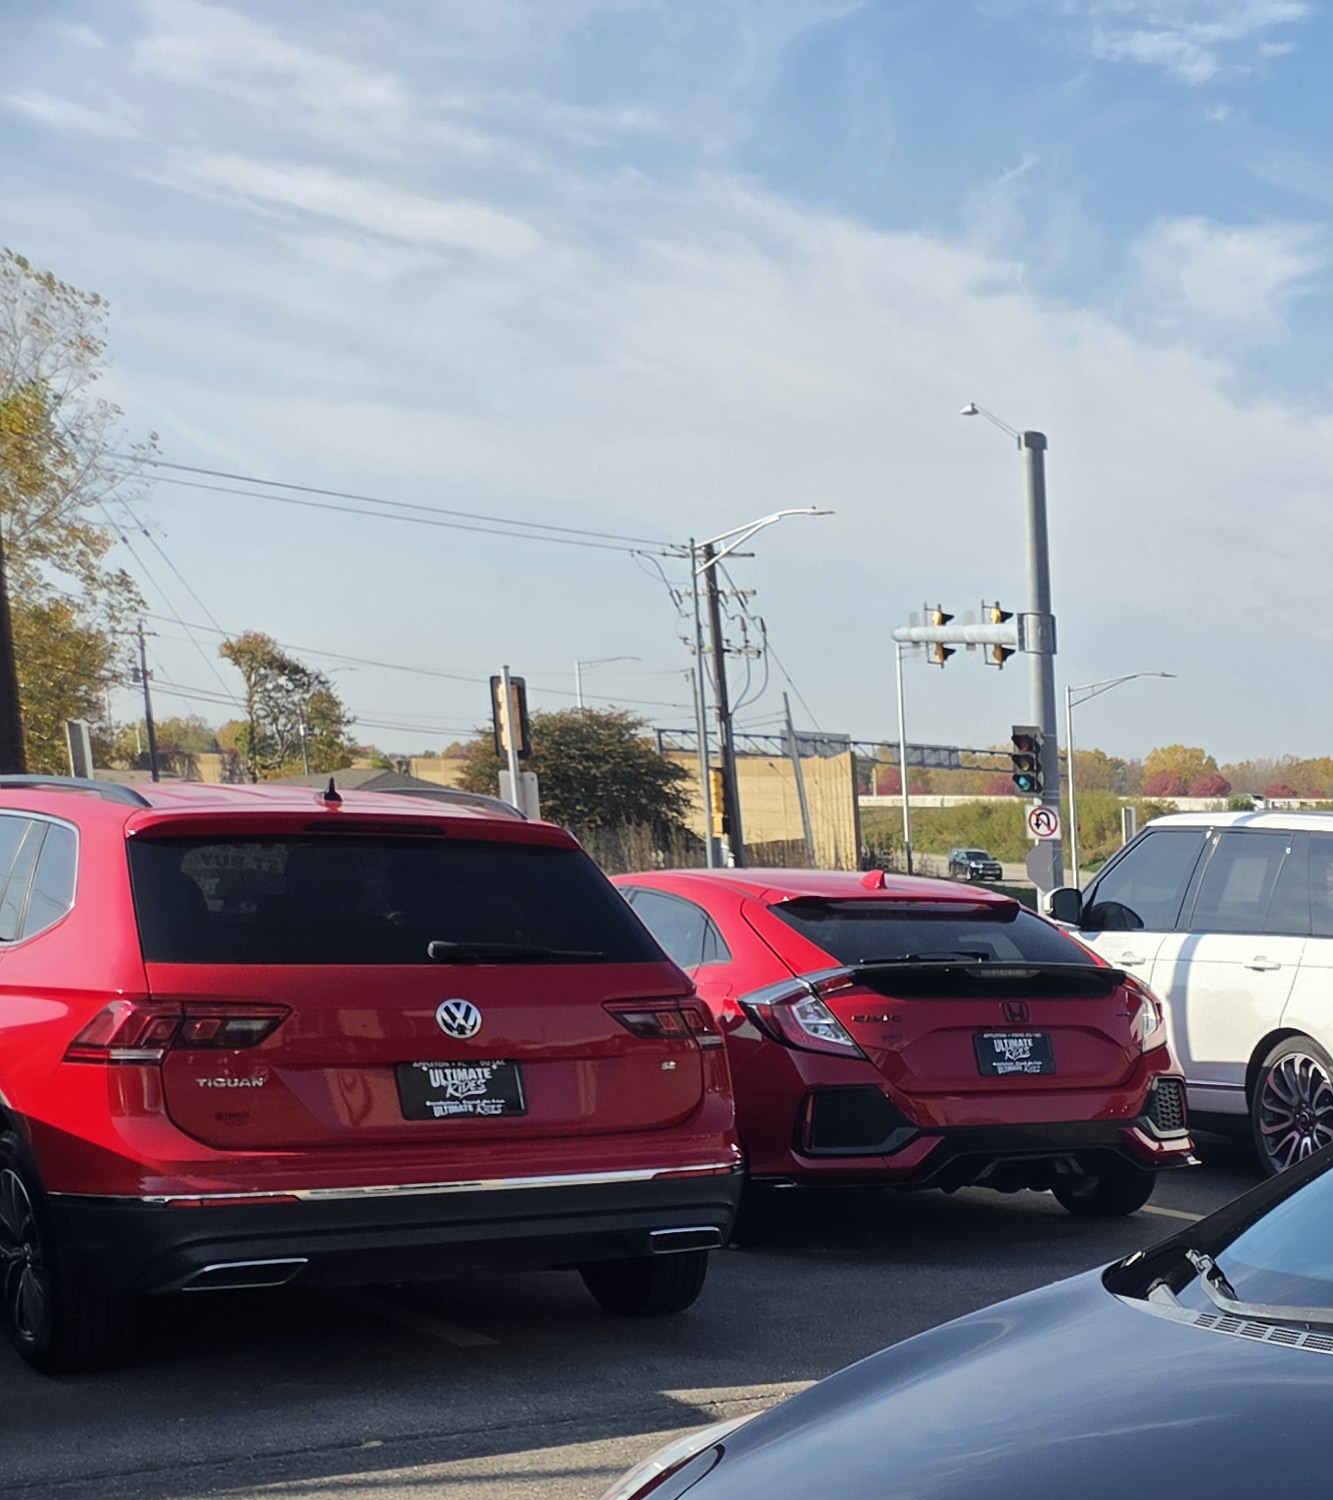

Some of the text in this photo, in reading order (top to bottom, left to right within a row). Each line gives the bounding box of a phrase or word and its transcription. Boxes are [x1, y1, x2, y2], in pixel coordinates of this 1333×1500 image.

[994, 1038, 1033, 1052] ULTIMATE
[195, 1077, 265, 1087] TIGUAN
[429, 1068, 492, 1088] ULTIMATE
[446, 1079, 487, 1099] RIDES
